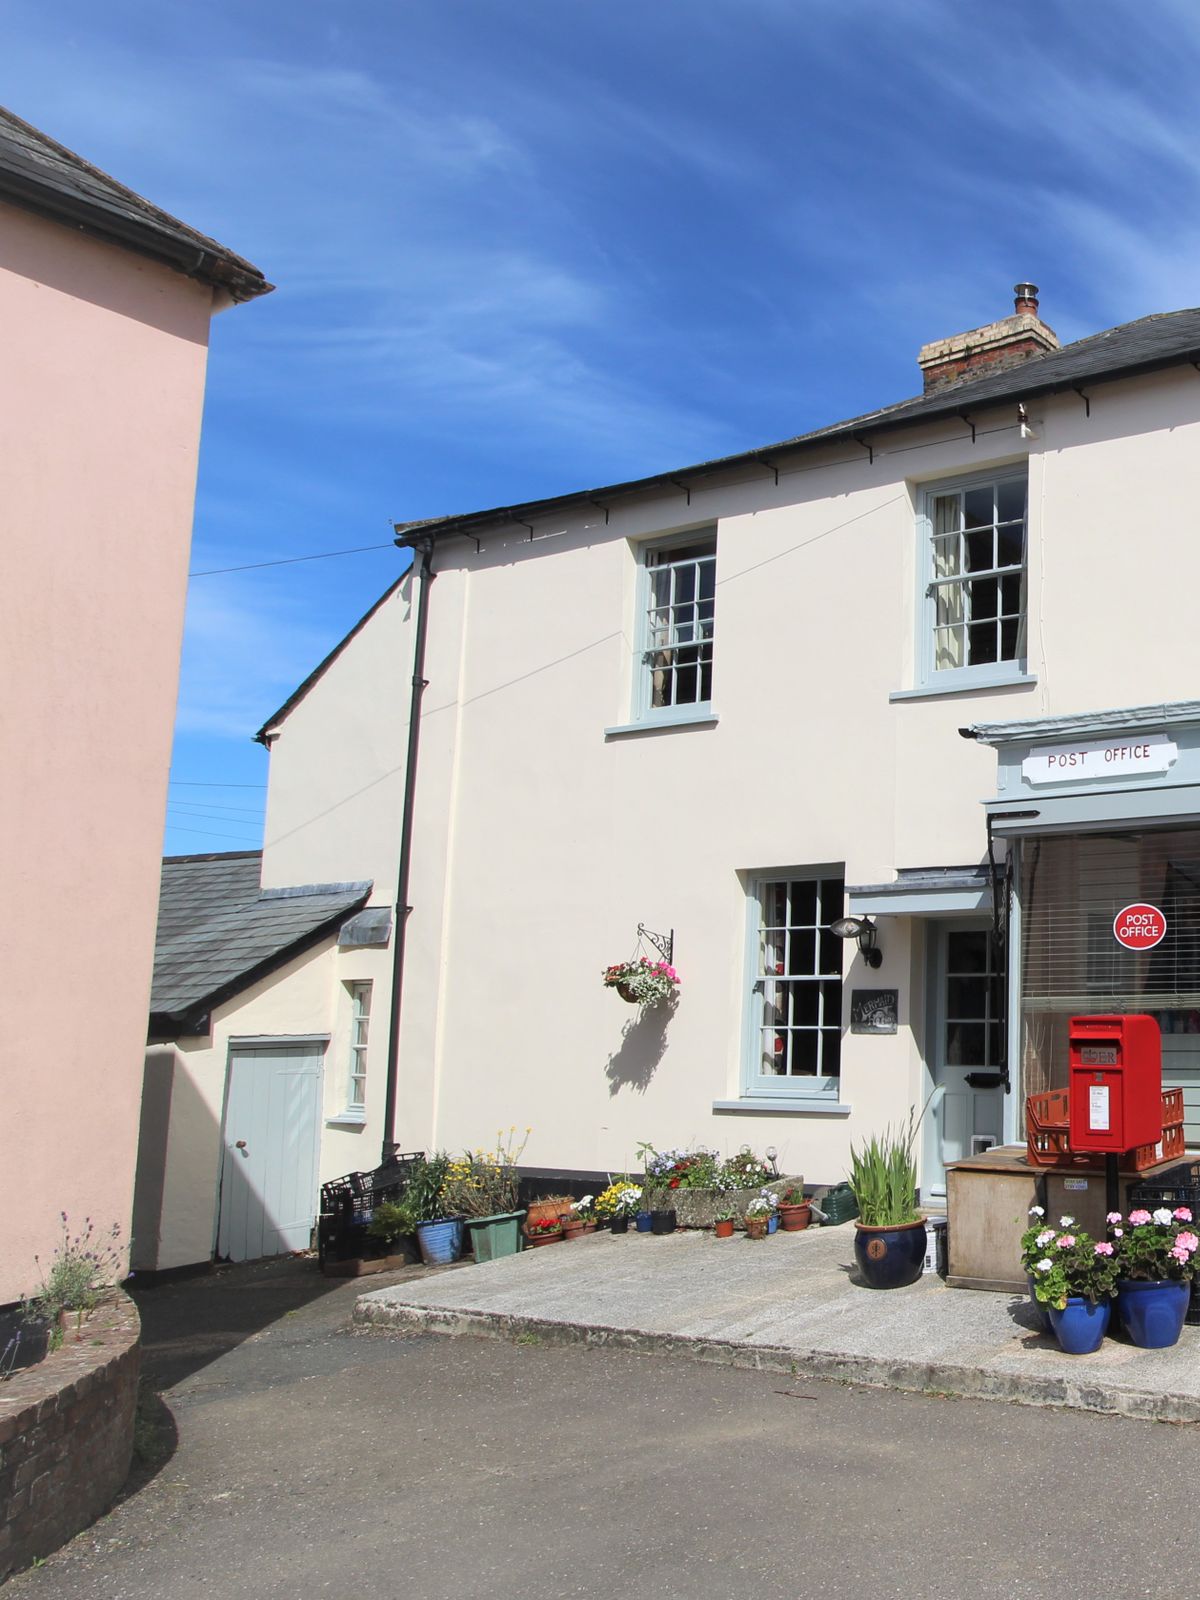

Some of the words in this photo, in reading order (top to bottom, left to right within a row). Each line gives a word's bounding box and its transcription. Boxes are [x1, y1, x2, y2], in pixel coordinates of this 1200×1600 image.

[1048, 751, 1088, 768] POST
[1104, 744, 1151, 763] OFFICE
[1126, 913, 1155, 926] POST
[1120, 925, 1159, 938] OFFICE
